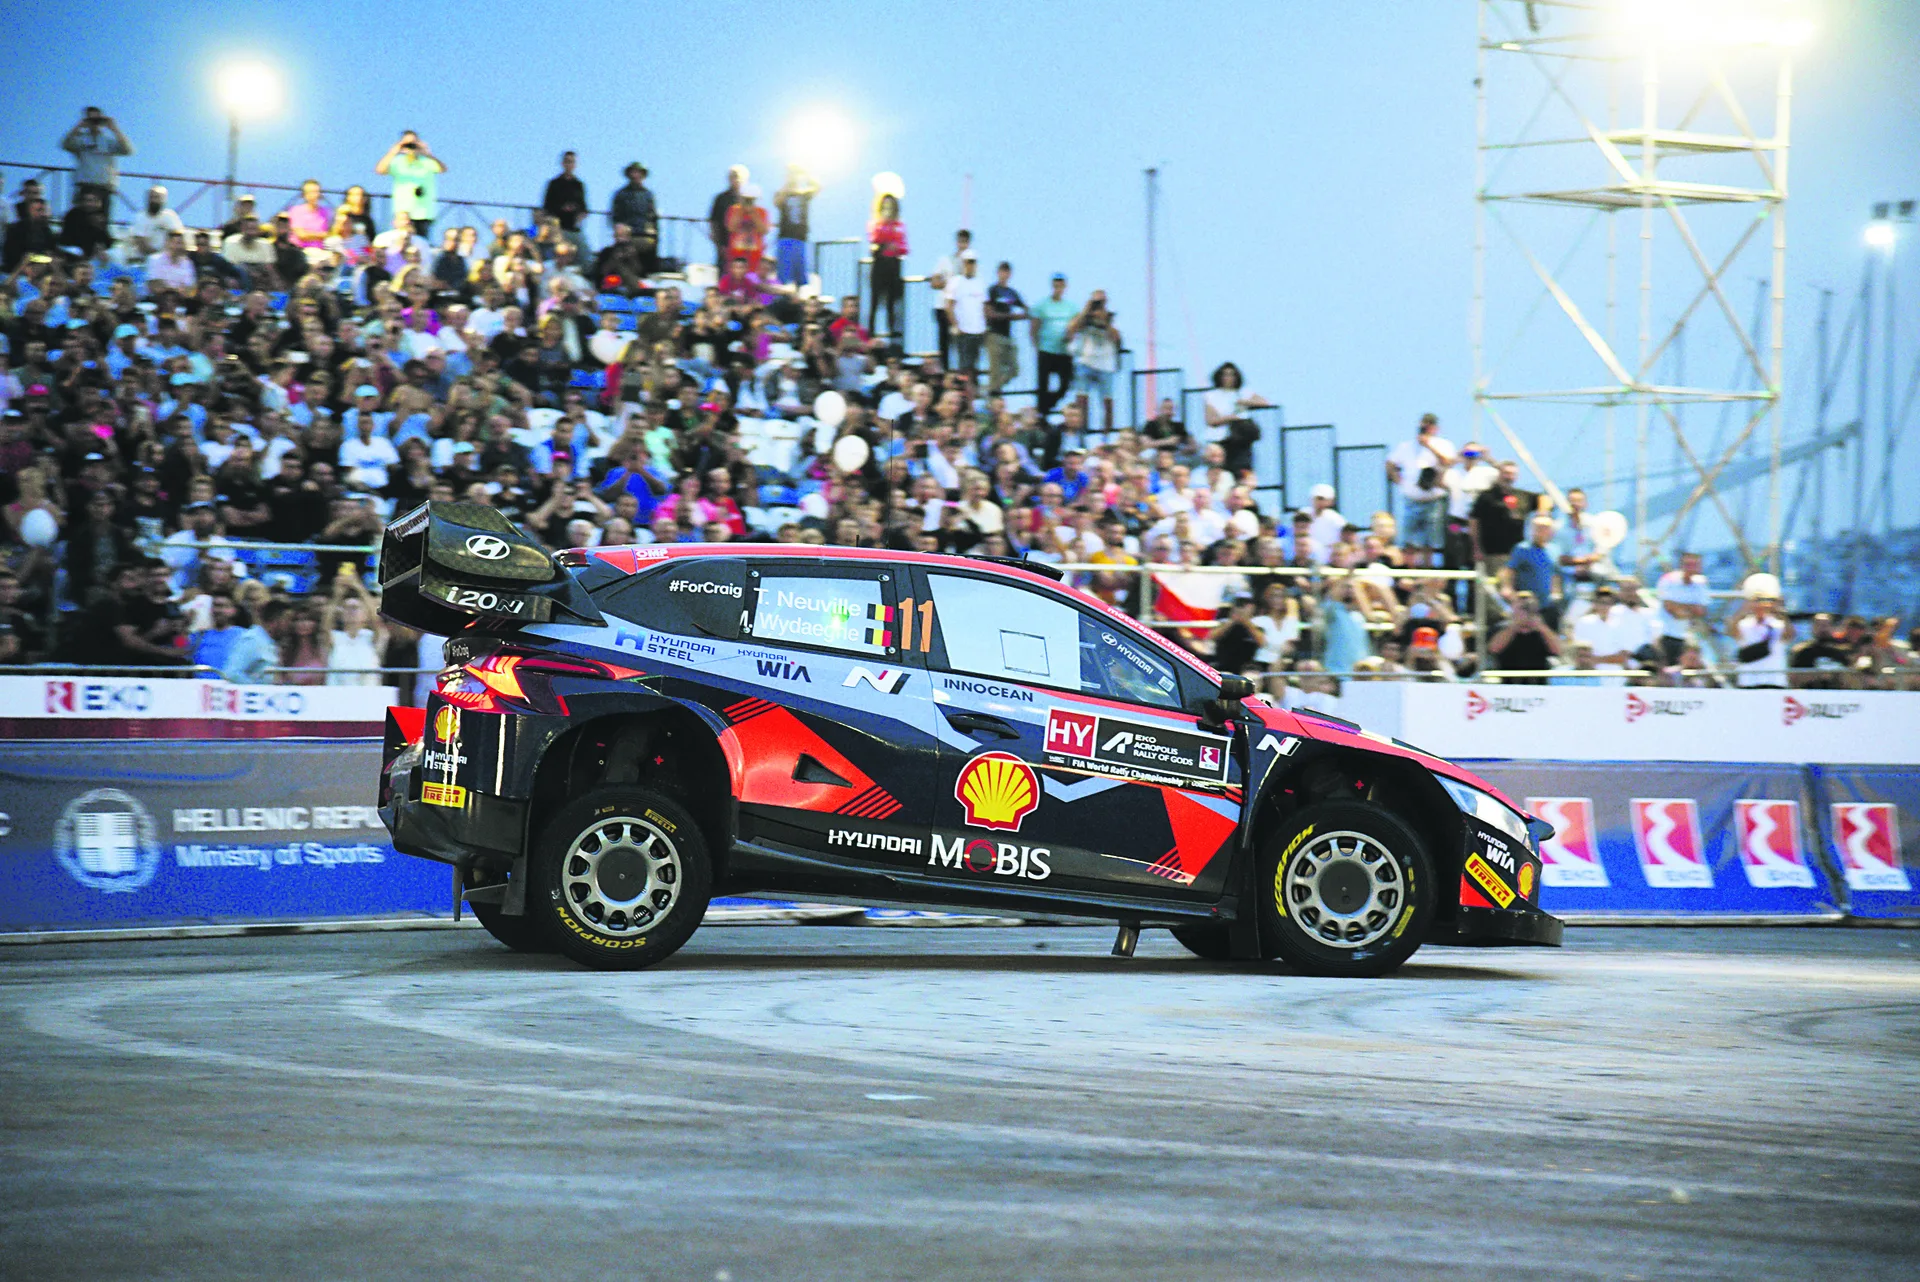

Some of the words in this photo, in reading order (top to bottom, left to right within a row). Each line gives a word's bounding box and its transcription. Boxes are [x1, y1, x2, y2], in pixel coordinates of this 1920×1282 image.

[635, 549, 669, 558] OMP
[669, 580, 743, 598] #ForCraig
[753, 587, 769, 606] T.
[777, 590, 862, 617] Neuville
[898, 597, 934, 653] 11
[647, 643, 695, 663] STEEL
[649, 634, 716, 655] HYUNDAI
[738, 649, 788, 661] HYUNDAI
[1107, 607, 1223, 682] motorsport.hyundai.co
[756, 659, 812, 683] WIA
[1117, 644, 1154, 675] HYUNDAI
[943, 678, 1034, 703] INNOCEAN
[1049, 718, 1093, 748] HY
[1134, 734, 1157, 744] EKO
[1133, 742, 1179, 756] ACROPOLIS
[1133, 749, 1157, 760] RALLY
[1158, 752, 1170, 762] OF
[1170, 754, 1194, 766] GODS
[1072, 759, 1085, 769] FIA
[1087, 760, 1109, 773] World
[1109, 765, 1130, 777] Rally
[1130, 769, 1184, 787] Championship
[423, 785, 461, 803] PIRELLI
[172, 806, 310, 832] HELLENIC
[311, 805, 387, 829] REPU
[644, 808, 677, 834] PIRELLI
[1477, 830, 1509, 852] HYUNDAI
[174, 844, 273, 871] Ministry
[273, 842, 303, 865] of
[303, 841, 386, 870] Sports
[827, 829, 922, 855] HYUNDAI
[928, 833, 1052, 880] MOBIS
[1486, 844, 1515, 874] WIA
[1469, 858, 1510, 902] PIRELLI
[556, 906, 648, 949] SCORPION
